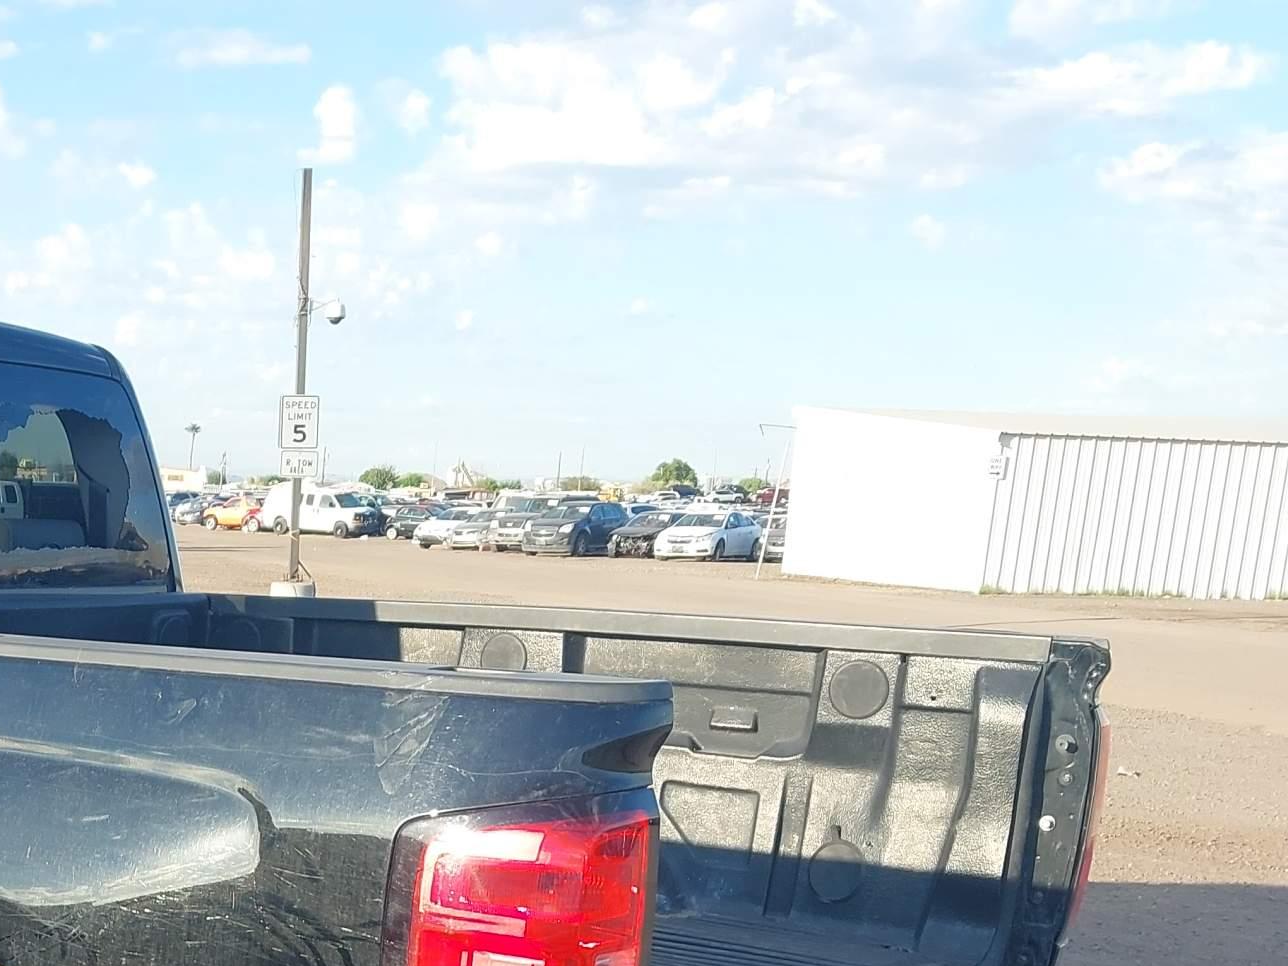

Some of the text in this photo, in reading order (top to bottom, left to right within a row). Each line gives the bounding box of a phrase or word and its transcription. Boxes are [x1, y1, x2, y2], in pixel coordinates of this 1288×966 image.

[285, 400, 317, 409] SPEED
[287, 412, 313, 421] LIMIT
[292, 423, 307, 443] 5
